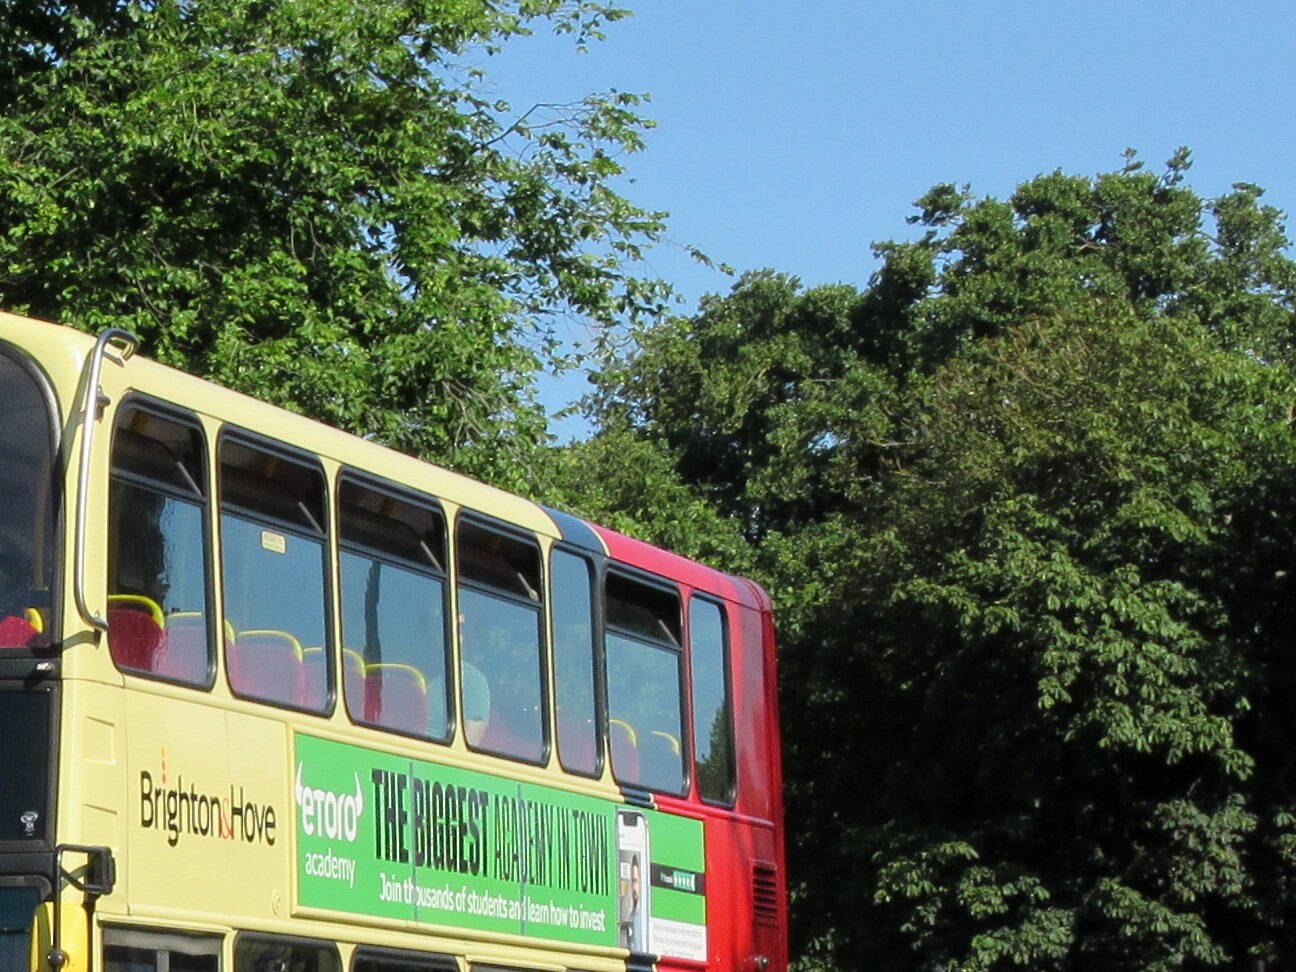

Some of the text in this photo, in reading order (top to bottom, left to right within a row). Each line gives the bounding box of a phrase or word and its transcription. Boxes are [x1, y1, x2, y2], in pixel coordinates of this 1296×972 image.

[140, 766, 276, 847] Brighton&Hove
[371, 768, 609, 897] THE BIGGEST ACADEMY IN TOWN
[305, 848, 356, 889] academy
[379, 872, 401, 902] Join
[403, 877, 454, 911] thousands
[455, 885, 467, 913] of
[467, 889, 507, 918] students
[527, 896, 549, 924] learn
[550, 899, 568, 926] how
[569, 904, 580, 928] to
[580, 903, 606, 932] invest
